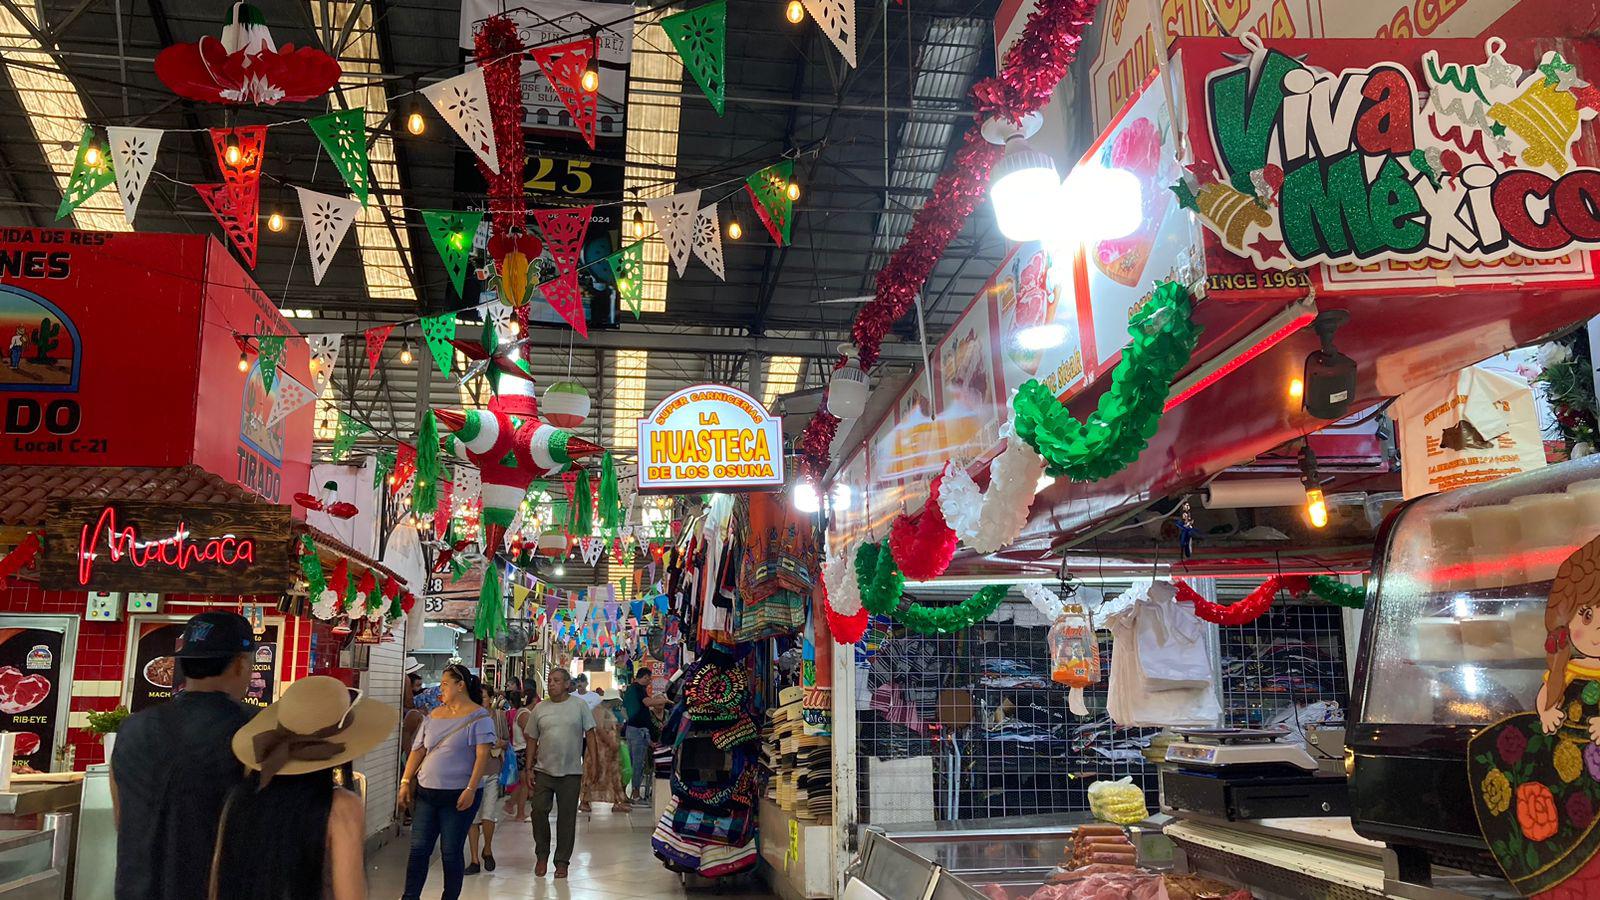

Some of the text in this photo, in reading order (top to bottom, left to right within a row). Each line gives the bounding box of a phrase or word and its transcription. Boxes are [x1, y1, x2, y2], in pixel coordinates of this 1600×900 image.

[521, 84, 541, 92] OSE
[1207, 48, 1416, 188] Viva
[523, 156, 593, 194] 25
[1279, 152, 1600, 260] México
[40, 230, 65, 243] DE
[655, 391, 763, 425] SUPER CARNICERIAS
[699, 412, 720, 425] LA
[15, 437, 108, 453] Local C-21
[650, 428, 771, 464] HUASTECA
[237, 446, 282, 505] TIRADO
[648, 463, 774, 480] DE LOS OSUNA
[79, 507, 253, 586] Machaca
[425, 596, 443, 612] 53
[12, 715, 48, 724] RIB-EYE
